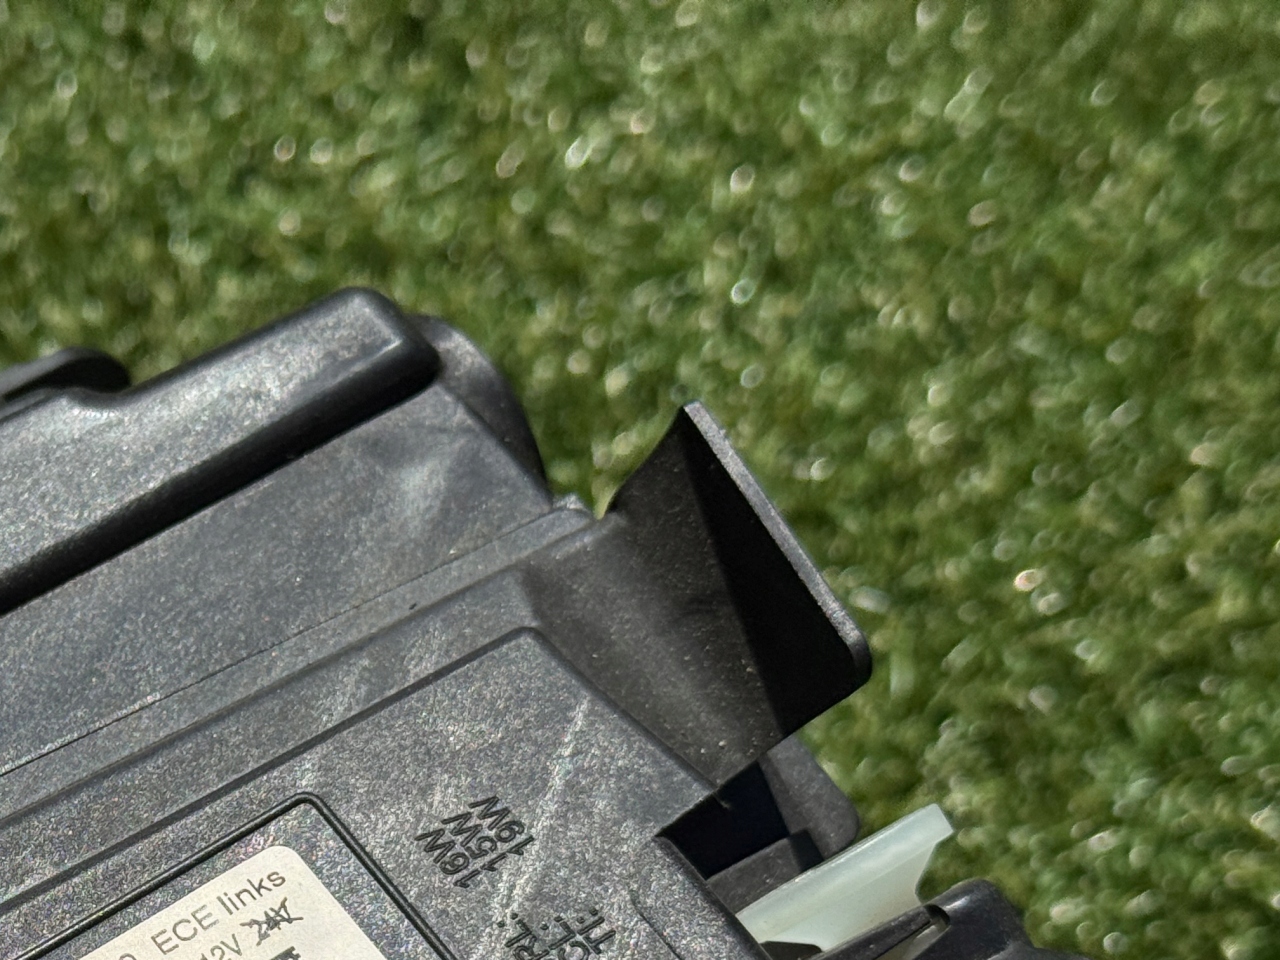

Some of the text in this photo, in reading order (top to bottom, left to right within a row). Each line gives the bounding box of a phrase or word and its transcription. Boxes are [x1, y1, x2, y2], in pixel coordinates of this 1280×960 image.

[413, 823, 482, 889] 16W
[441, 809, 510, 875] 15W
[467, 793, 535, 859] 19W
[151, 904, 219, 956] ECE
[216, 871, 286, 915] links
